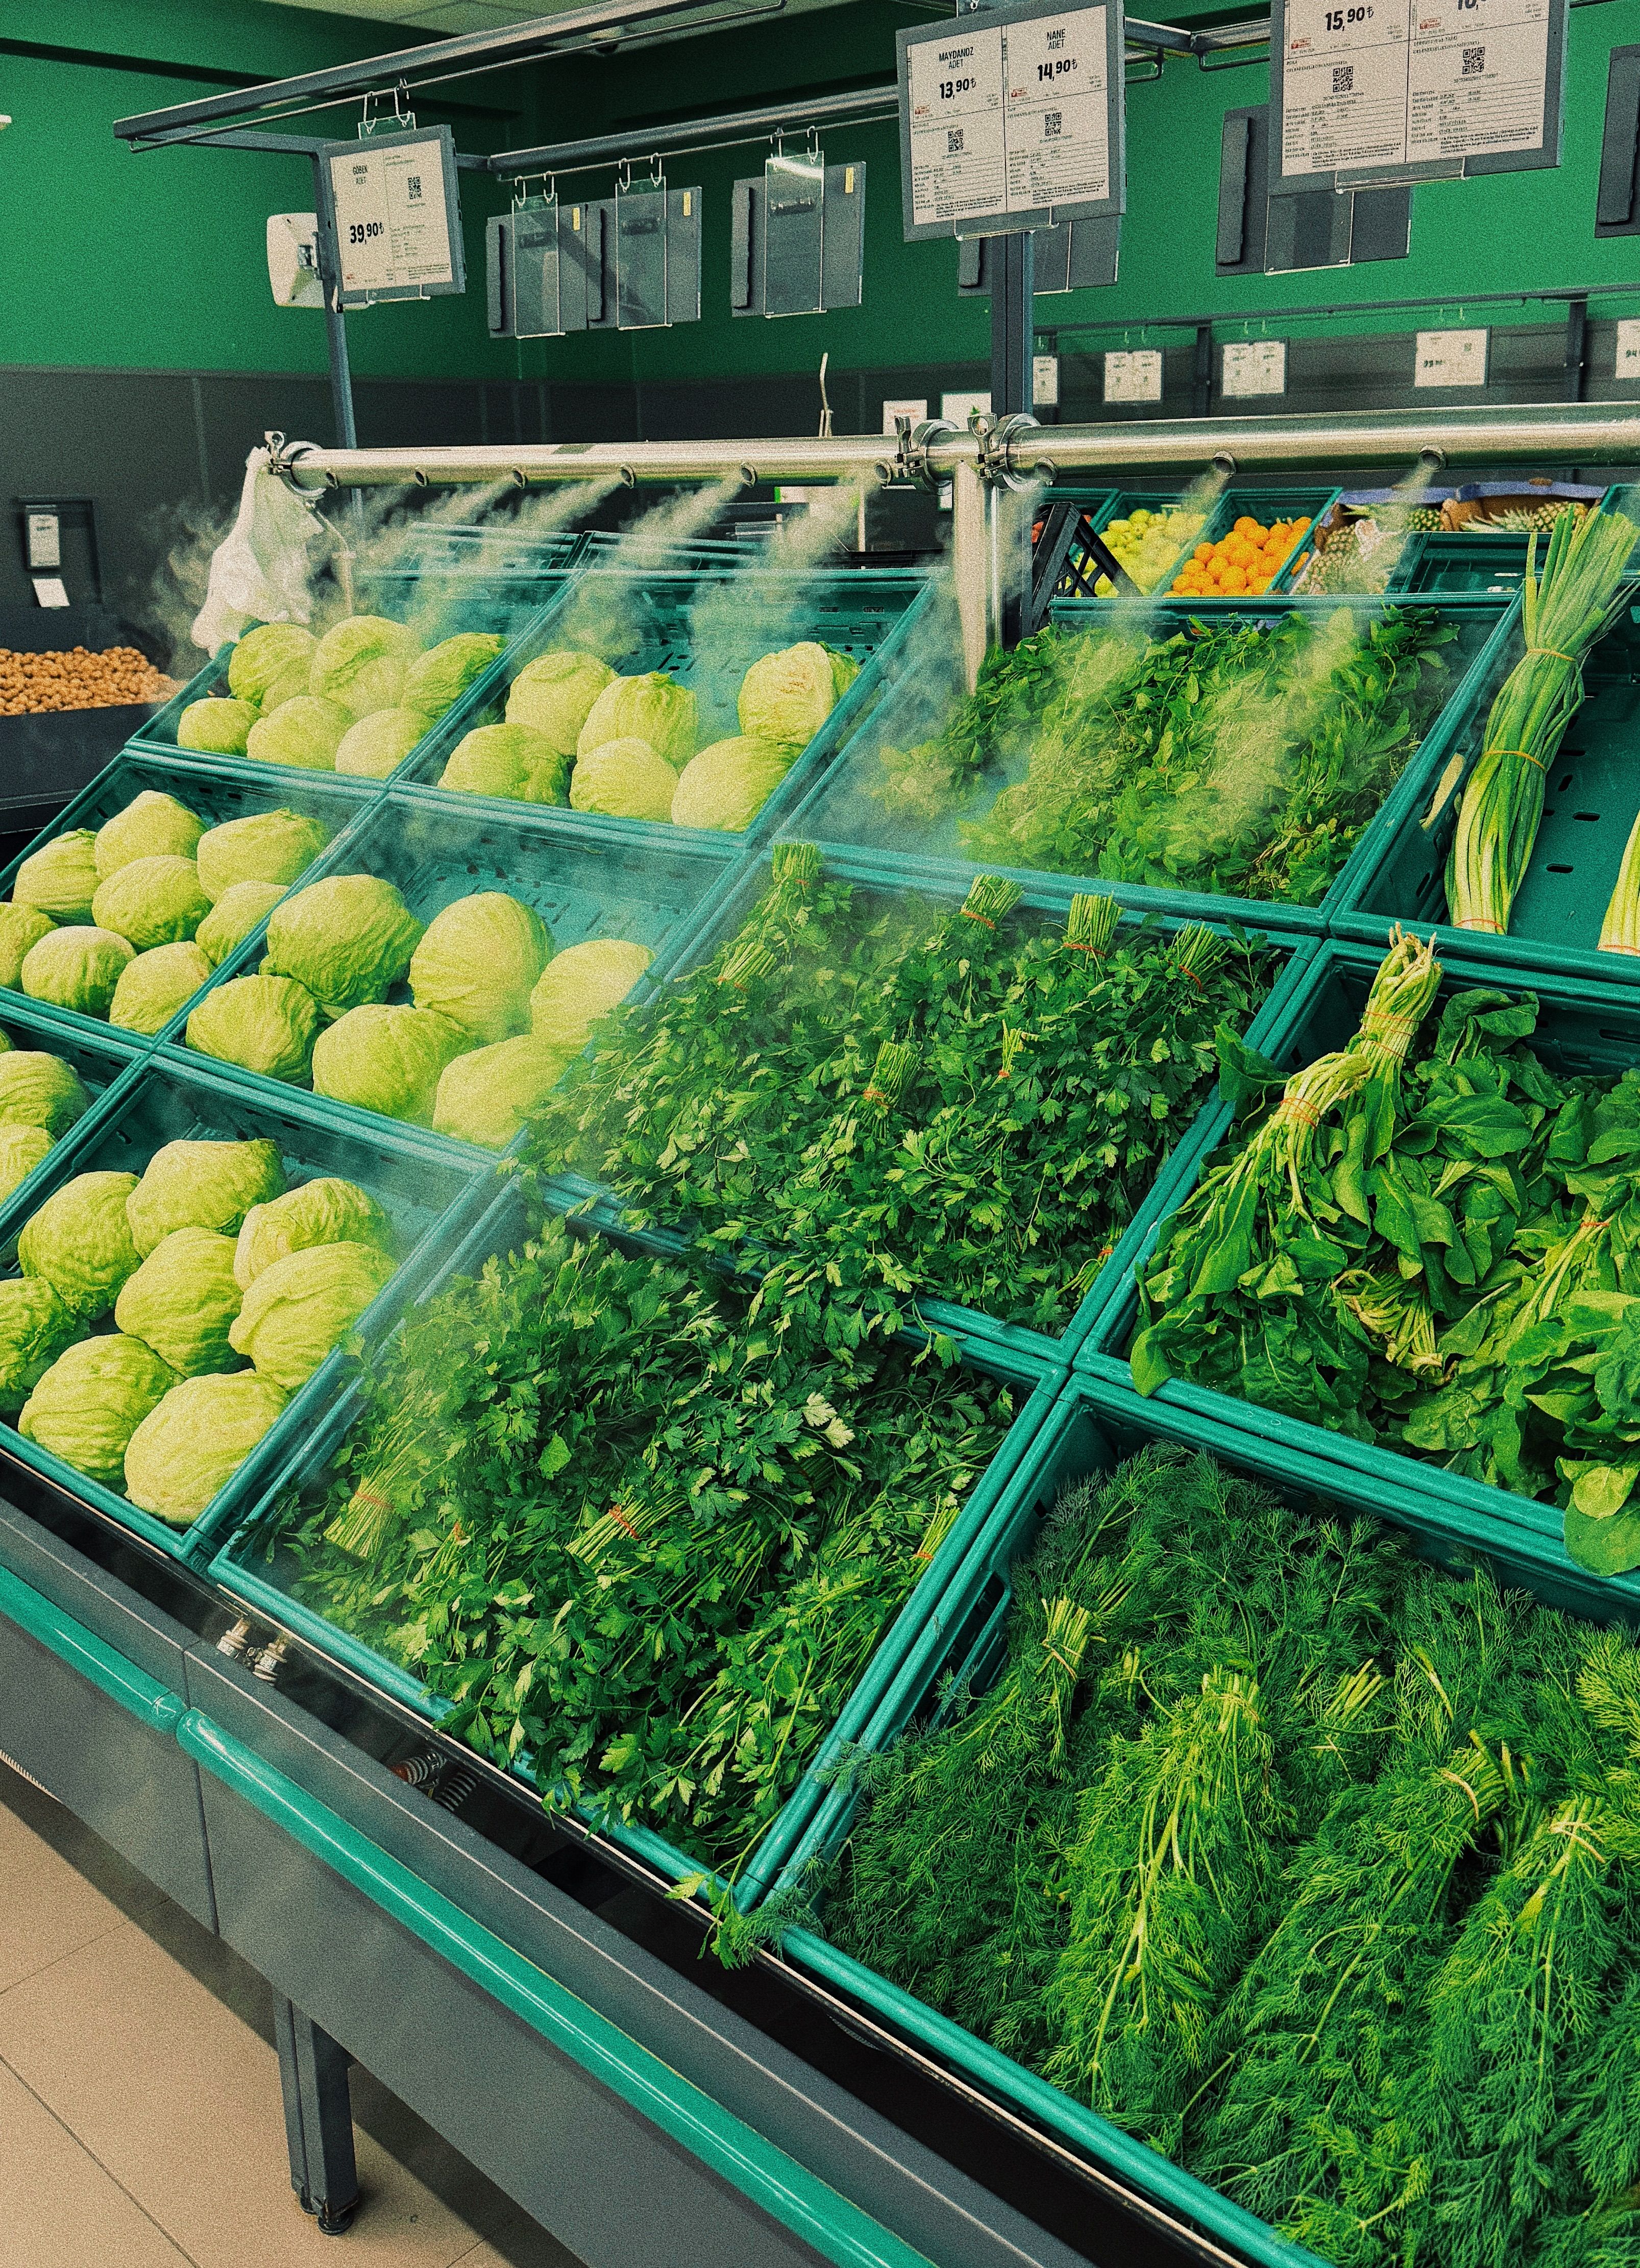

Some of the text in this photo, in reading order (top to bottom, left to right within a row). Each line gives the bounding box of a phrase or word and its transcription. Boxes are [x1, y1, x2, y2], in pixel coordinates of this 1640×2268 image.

[1047, 29, 1066, 40] NANE
[1048, 39, 1064, 50] ADET
[939, 47, 973, 61] MAYDANOZ
[949, 59, 963, 69] ADET
